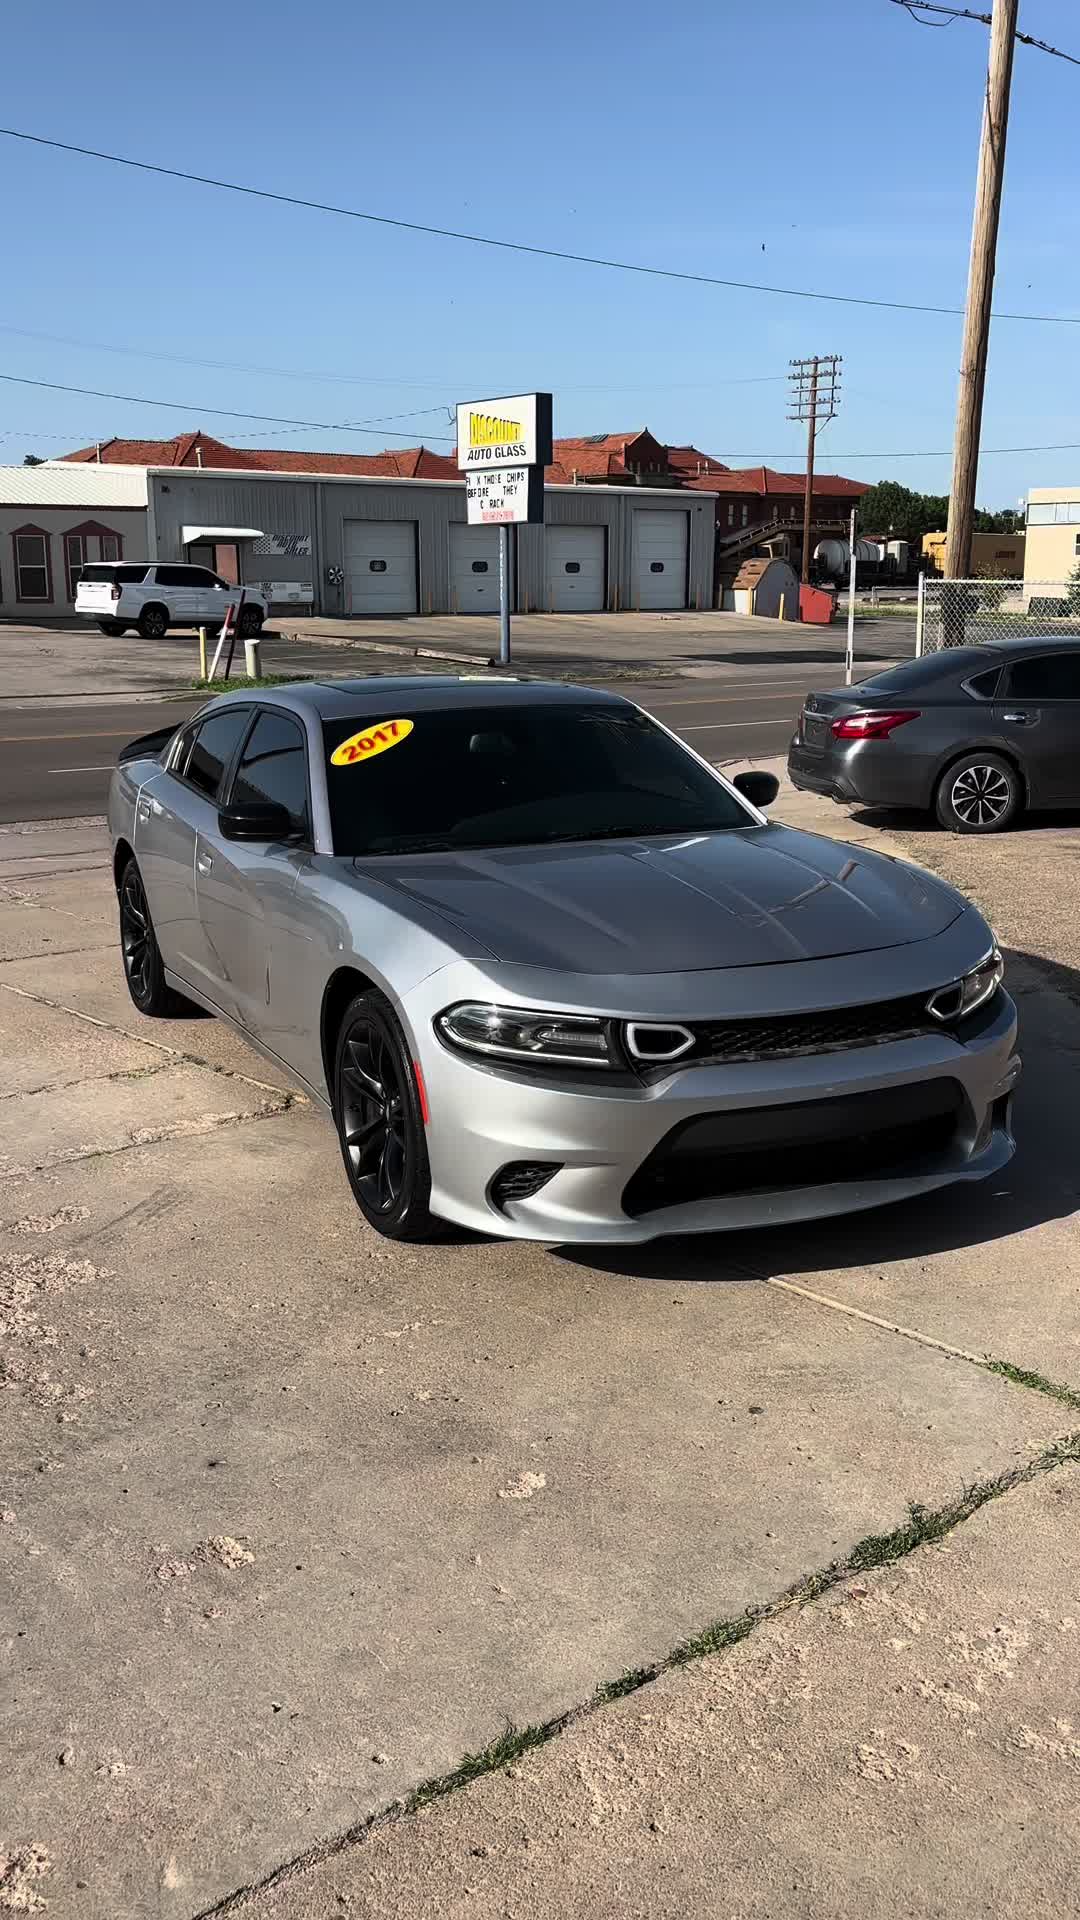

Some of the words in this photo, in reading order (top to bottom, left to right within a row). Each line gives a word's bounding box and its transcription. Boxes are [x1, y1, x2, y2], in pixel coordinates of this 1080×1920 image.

[470, 412, 522, 446] DISCOUNT
[467, 447, 492, 461] AUTO
[495, 444, 527, 459] GLASS
[506, 471, 525, 483] CHIPS
[467, 487, 489, 499] BEFORE
[503, 484, 518, 496] THEY
[341, 721, 400, 762] 2017
